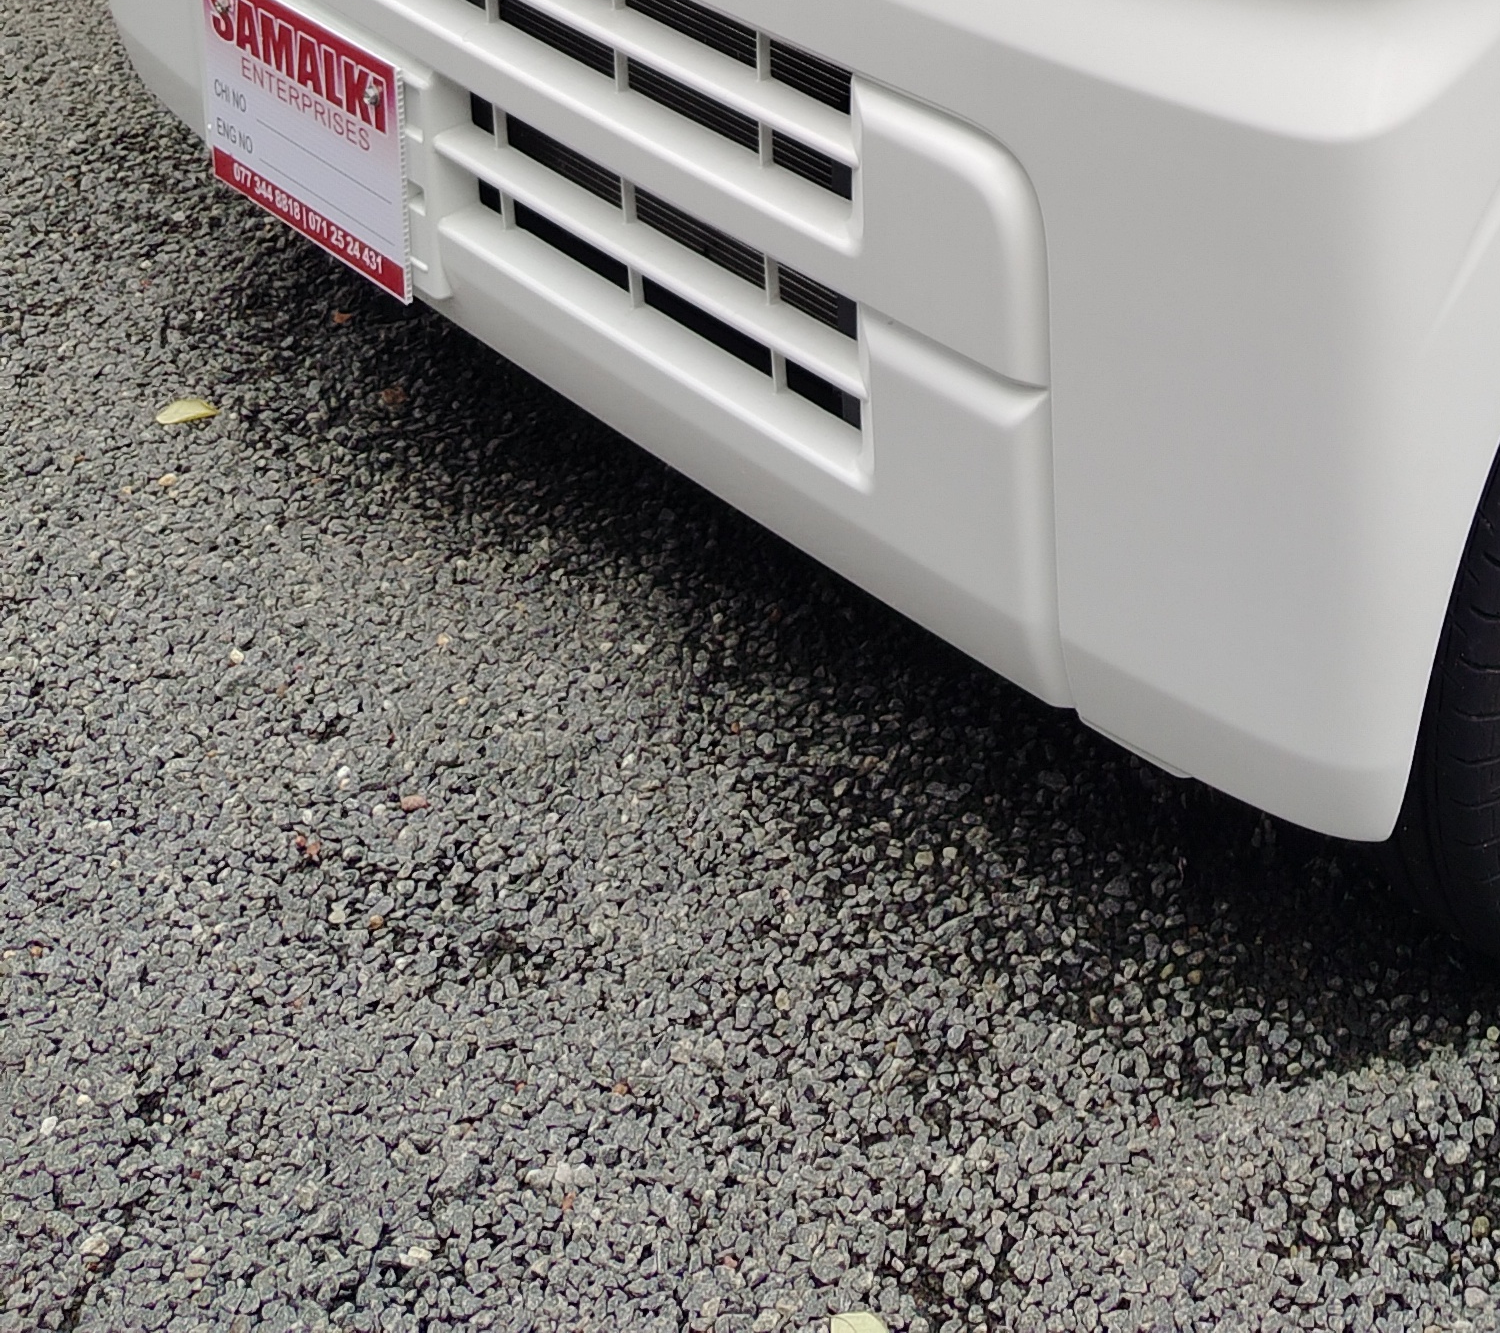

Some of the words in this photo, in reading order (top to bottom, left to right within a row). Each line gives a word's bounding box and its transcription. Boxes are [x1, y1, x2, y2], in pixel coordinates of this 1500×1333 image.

[232, 89, 248, 113] NO
[241, 55, 371, 152] ENTERPRISES
[216, 116, 238, 144] ENG
[238, 128, 254, 155] NO
[232, 161, 252, 188] 077
[253, 175, 274, 203] 344
[308, 211, 328, 239] 071
[330, 225, 345, 250] 25
[346, 236, 362, 260] 24
[362, 247, 384, 275] 431
